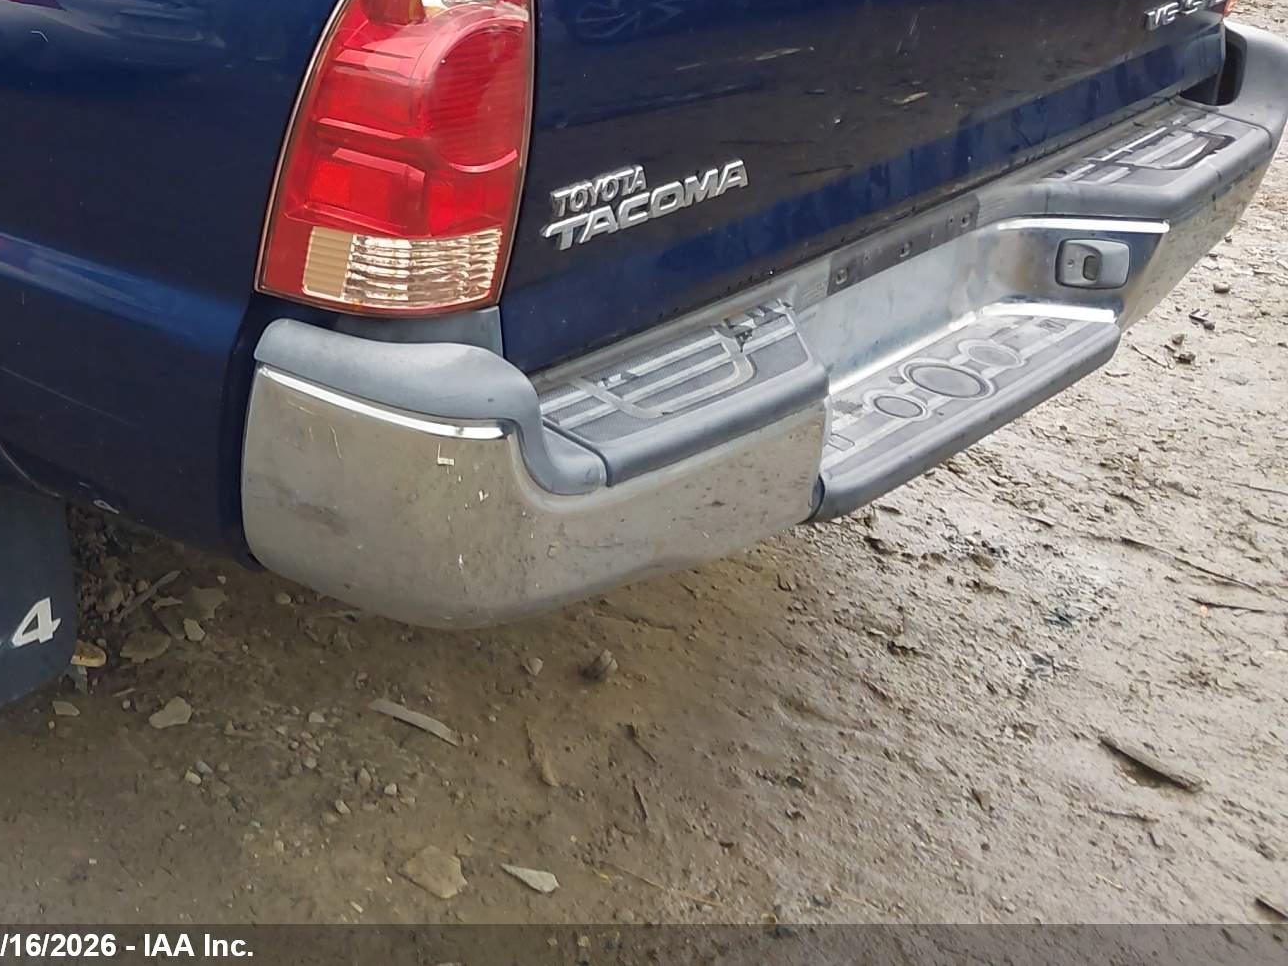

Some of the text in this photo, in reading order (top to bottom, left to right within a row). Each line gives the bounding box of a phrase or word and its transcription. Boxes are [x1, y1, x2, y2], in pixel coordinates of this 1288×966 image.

[540, 159, 749, 251] TACOMA
[550, 164, 647, 217] TOYOTA
[11, 596, 62, 648] 4
